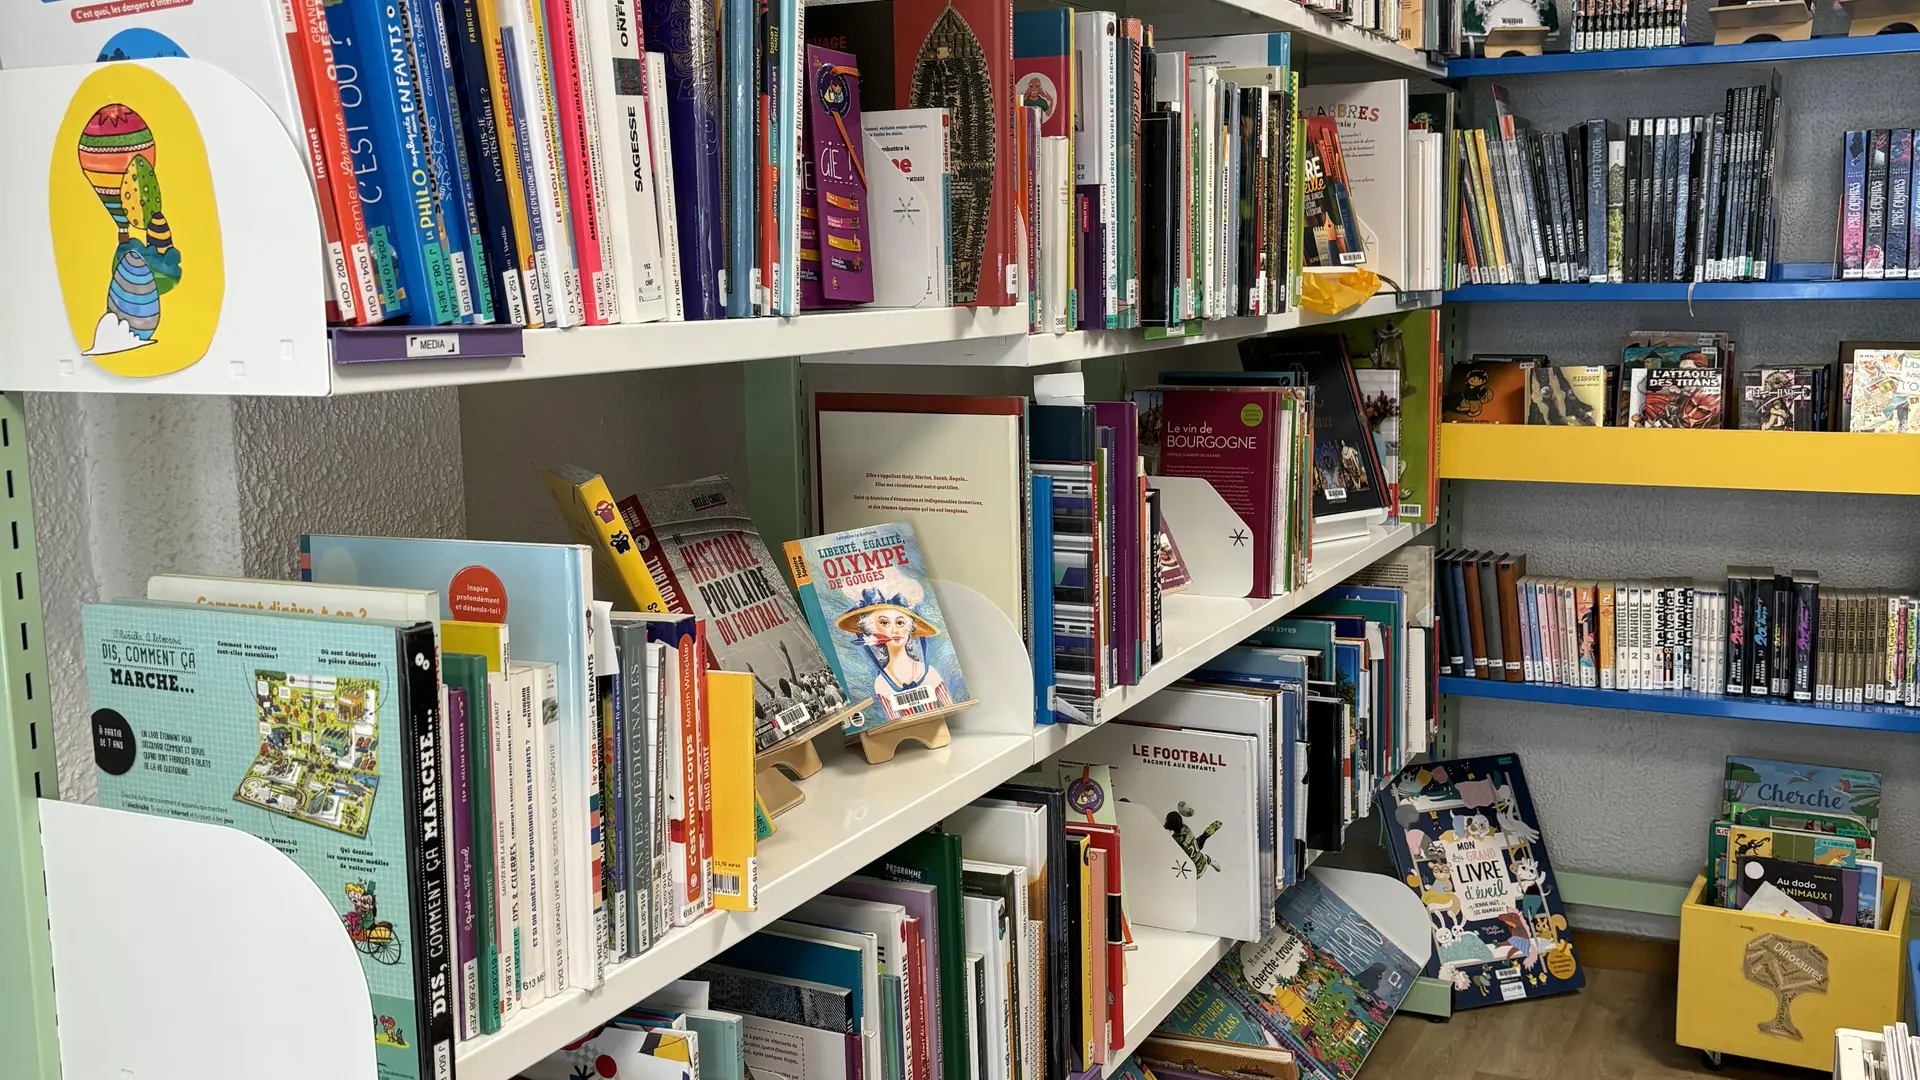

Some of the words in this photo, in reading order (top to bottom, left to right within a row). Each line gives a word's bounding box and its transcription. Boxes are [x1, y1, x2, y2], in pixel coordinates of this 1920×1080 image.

[76, 10, 93, 20] C'est
[94, 6, 111, 18] quoi,
[112, 5, 121, 14] les
[122, 1, 150, 13] dangers
[567, 17, 572, 28] ET
[466, 7, 476, 43] FABRICE
[569, 30, 577, 69] SANDRA
[388, 24, 415, 113] ENFANTS
[335, 113, 353, 176] Larousse
[478, 117, 491, 157] SUIS-JE
[519, 117, 532, 162] AFFECTIVE
[542, 115, 555, 169] MAGIQUE
[627, 106, 644, 192] SAGESSE
[1592, 137, 1601, 163] TOOTH
[309, 127, 326, 180] Internet
[1593, 163, 1601, 188] SWEET
[412, 169, 436, 229] PHILO
[551, 173, 562, 211] BISOU
[348, 184, 367, 246] premier
[556, 214, 562, 223] LE
[336, 259, 346, 278] 002
[377, 241, 391, 275] 034.10
[1111, 258, 1116, 269] LA
[359, 256, 373, 292] 034.10
[366, 295, 378, 316] GUI
[431, 258, 443, 286] 108.2
[437, 291, 448, 314] BEN
[457, 269, 466, 286] 070
[529, 273, 537, 290] 153
[539, 252, 550, 290] 155.232
[545, 293, 554, 315] AUB
[564, 270, 572, 296] 155.4
[595, 277, 603, 294] 158
[340, 282, 352, 308] COP
[383, 280, 396, 305] MAR
[460, 290, 471, 313] EUS
[508, 275, 518, 301] 152.4
[513, 304, 522, 324] MID
[420, 339, 445, 350] MEDIA
[1650, 378, 1673, 387] DES
[1674, 378, 1720, 387] TITANS
[1652, 369, 1717, 379] L'ATTAQUE
[1167, 421, 1180, 433] Le
[1183, 424, 1197, 434] vin
[1200, 420, 1213, 434] de
[1167, 435, 1257, 450] BOURGOGNE
[680, 531, 760, 585] HISTOIRE
[818, 540, 862, 559] LIBERTÉ,
[863, 533, 906, 550] ÉGALITÉ,
[792, 556, 802, 579] Histoire
[823, 545, 909, 579] OLYMPE
[467, 584, 489, 593] Inspire
[699, 566, 776, 618] POPULAIRE
[828, 578, 843, 590] DE
[846, 570, 885, 586] GOUGES
[456, 594, 500, 605] profondément
[1603, 594, 1611, 603] 2
[715, 616, 738, 646] DU
[736, 598, 790, 641] FOOTBALL
[1618, 602, 1627, 648] MANHOLE
[1630, 602, 1639, 648] MANHOLE
[1642, 602, 1652, 649] MANHOLE
[1655, 591, 1665, 647] helvetica
[1665, 590, 1675, 647] helvetica
[1675, 590, 1684, 647] helvetica
[1684, 590, 1694, 647] helvetica
[101, 643, 122, 664] DIS,
[125, 647, 175, 666] COMMENT
[180, 651, 196, 669] ÇA
[1644, 652, 1651, 660] 3
[110, 668, 195, 694] MARCHE...
[100, 737, 106, 747] DE
[113, 740, 123, 749] ANS
[104, 727, 122, 738] PARTIR
[631, 663, 643, 807] MÉDICINALES
[686, 733, 695, 782] corps
[703, 745, 711, 780] HONTE
[1132, 744, 1149, 756] LE
[1154, 747, 1227, 767] FOOTBALL
[1143, 758, 1171, 767] RACONTÉ
[1187, 763, 1216, 773] ENFANTS
[419, 708, 439, 841] MARCHE...
[591, 776, 597, 786] le
[1757, 783, 1844, 809] Cherche
[688, 827, 696, 866] c'est
[1457, 841, 1476, 851] MON
[1466, 848, 1497, 862] GRAND
[885, 864, 922, 879] PROGRAMME
[1456, 860, 1503, 884] LIVRE
[1777, 877, 1789, 886] Au
[1791, 879, 1817, 890] dodo
[1464, 879, 1508, 900] d'éveil
[428, 881, 444, 958] COMMENT
[1321, 913, 1384, 976] MARINS
[1252, 958, 1279, 990] cherche
[1277, 935, 1299, 967] trouve
[1773, 942, 1824, 981] Dinosaures
[431, 963, 448, 1018] DIS,
[902, 954, 910, 1020] PEINTURE
[1214, 1013, 1240, 1040] OCÉANS
